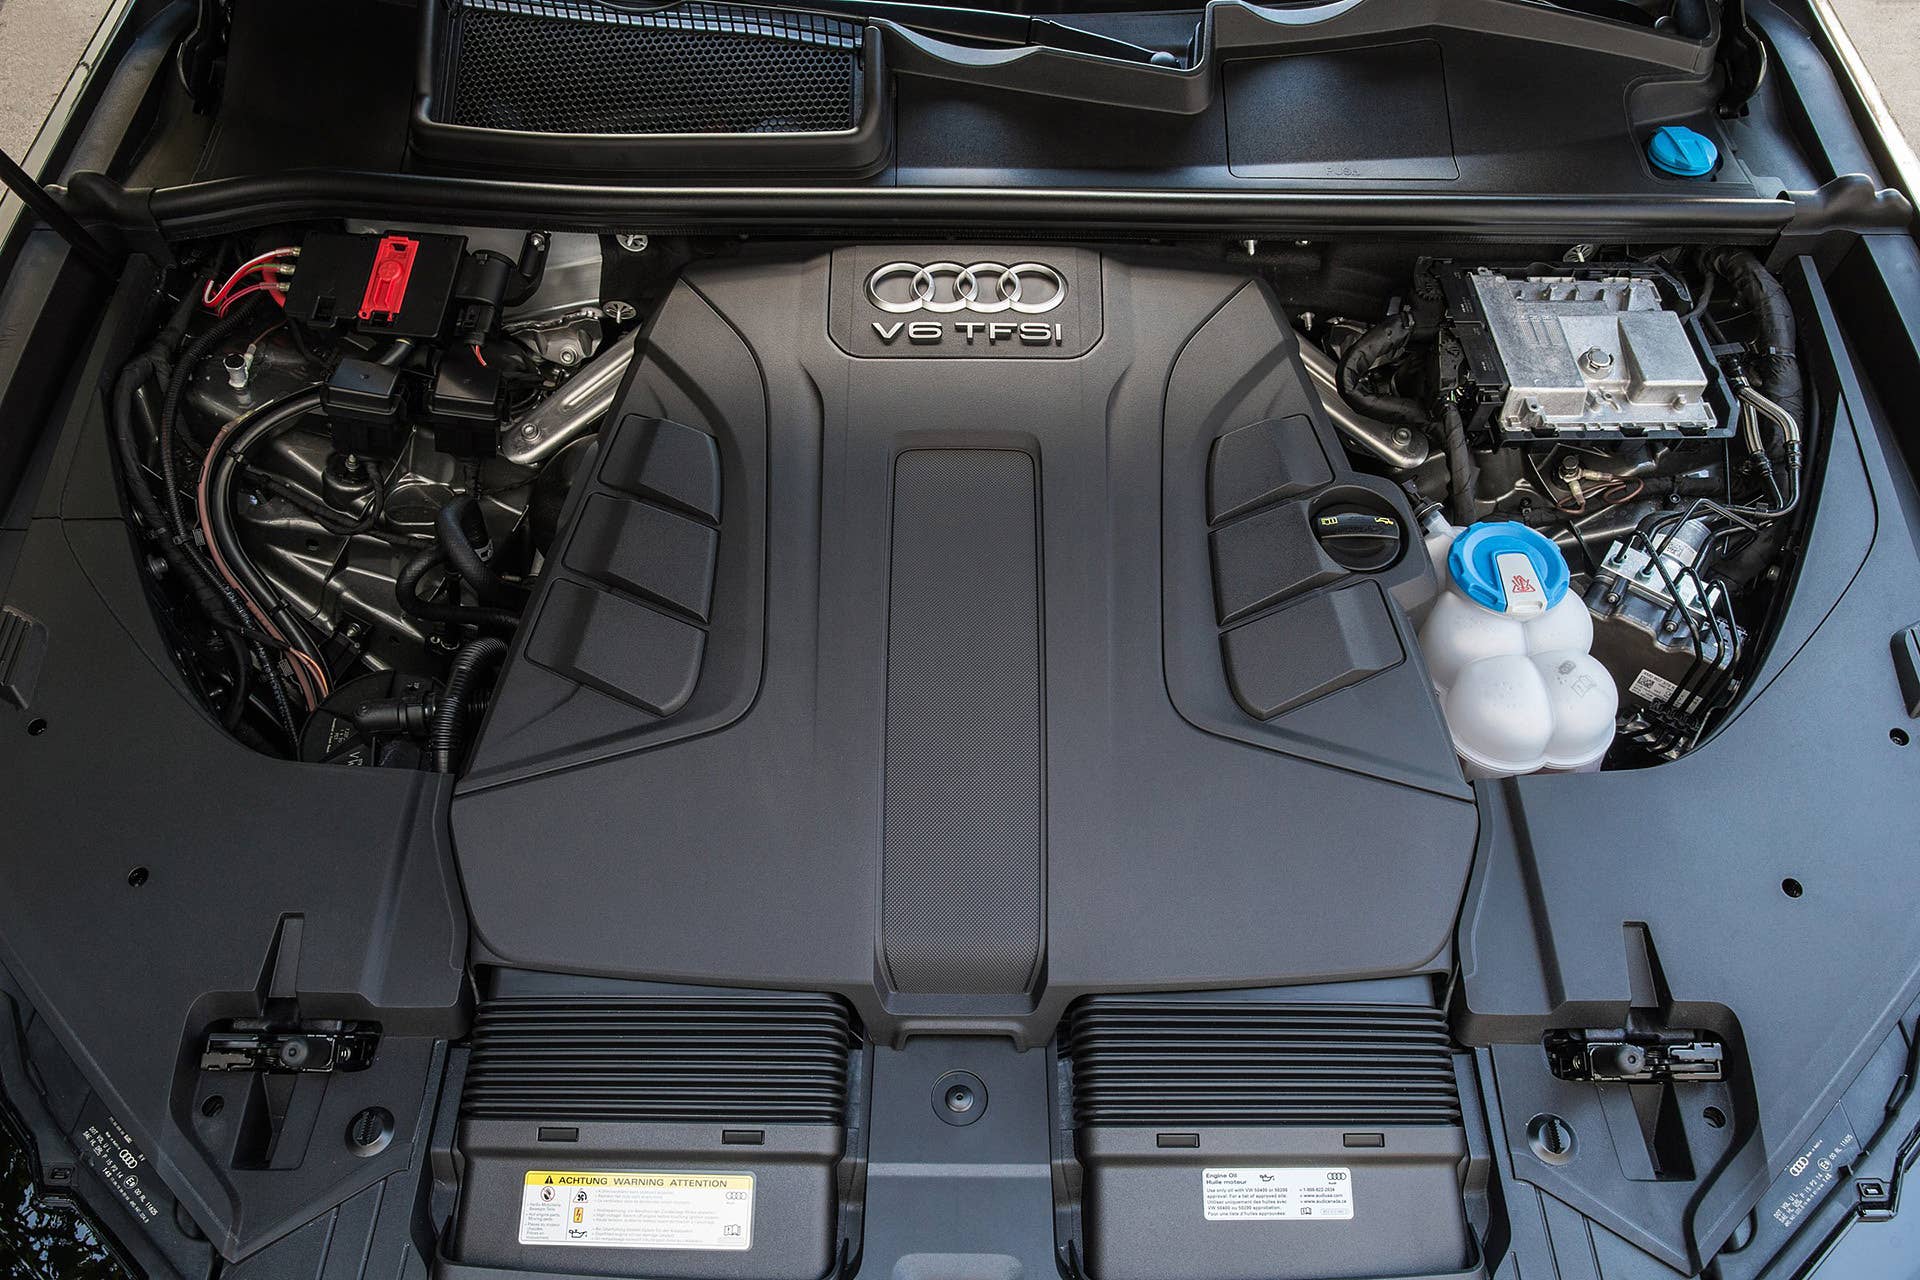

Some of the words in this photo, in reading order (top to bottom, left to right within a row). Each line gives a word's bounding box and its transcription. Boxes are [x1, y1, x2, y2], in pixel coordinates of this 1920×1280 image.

[872, 322, 943, 346] V6
[954, 322, 1062, 346] TFSI
[558, 1177, 608, 1185] ACHTUNG
[613, 1178, 664, 1187] WARNING
[670, 1179, 728, 1188] ATTENTION
